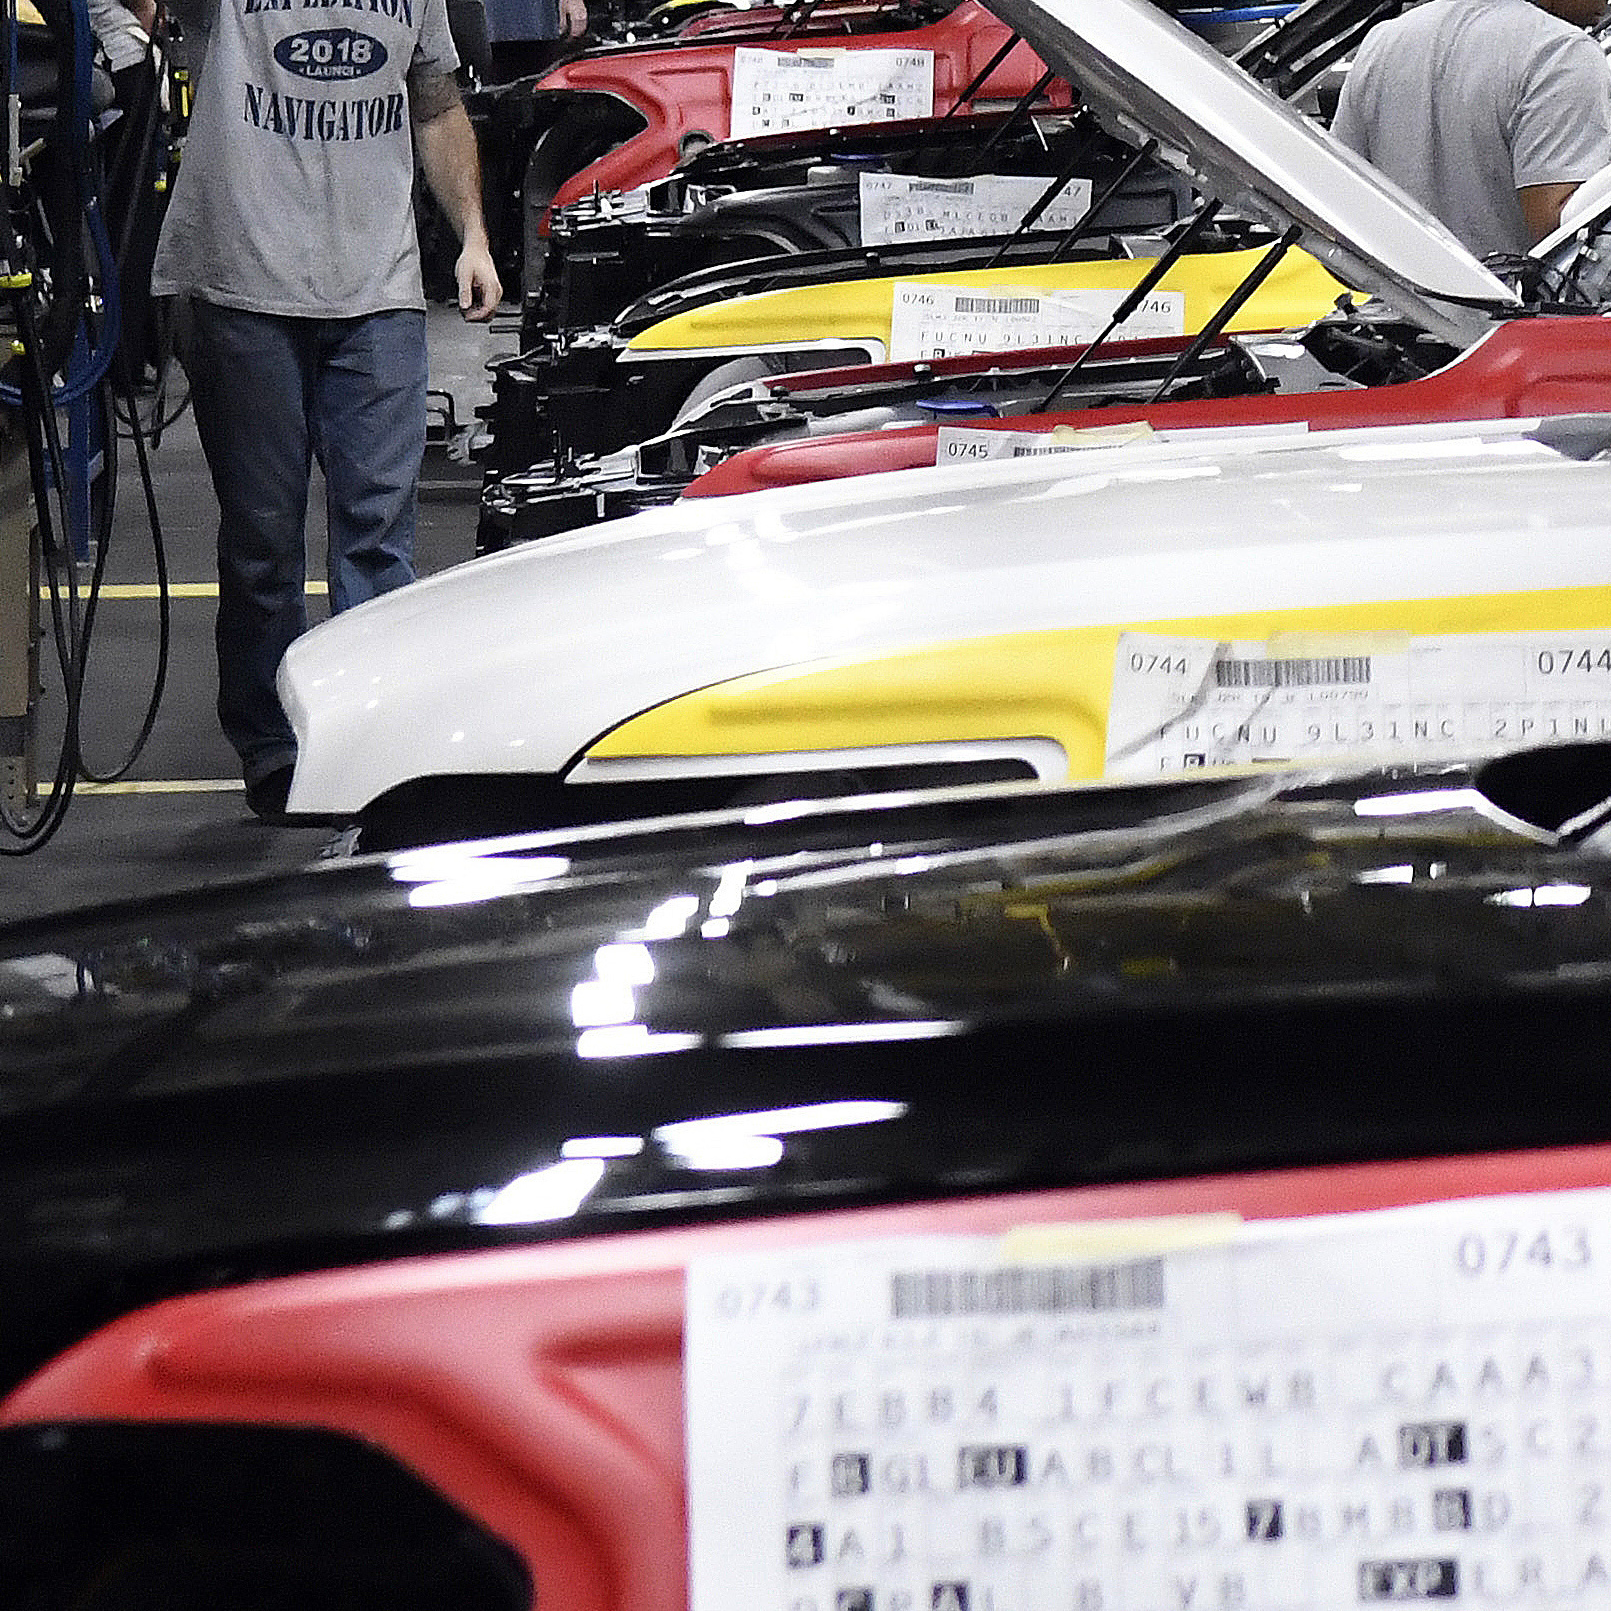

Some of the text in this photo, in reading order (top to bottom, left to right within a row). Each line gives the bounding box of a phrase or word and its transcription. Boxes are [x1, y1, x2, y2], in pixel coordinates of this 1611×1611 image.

[289, 38, 374, 64] 2018
[244, 82, 404, 141] NAVIGATOR
[902, 293, 1172, 314] 0746 746
[948, 442, 989, 459] 0745
[1130, 652, 1188, 676] 0744
[1455, 1227, 1593, 1277] 0743
